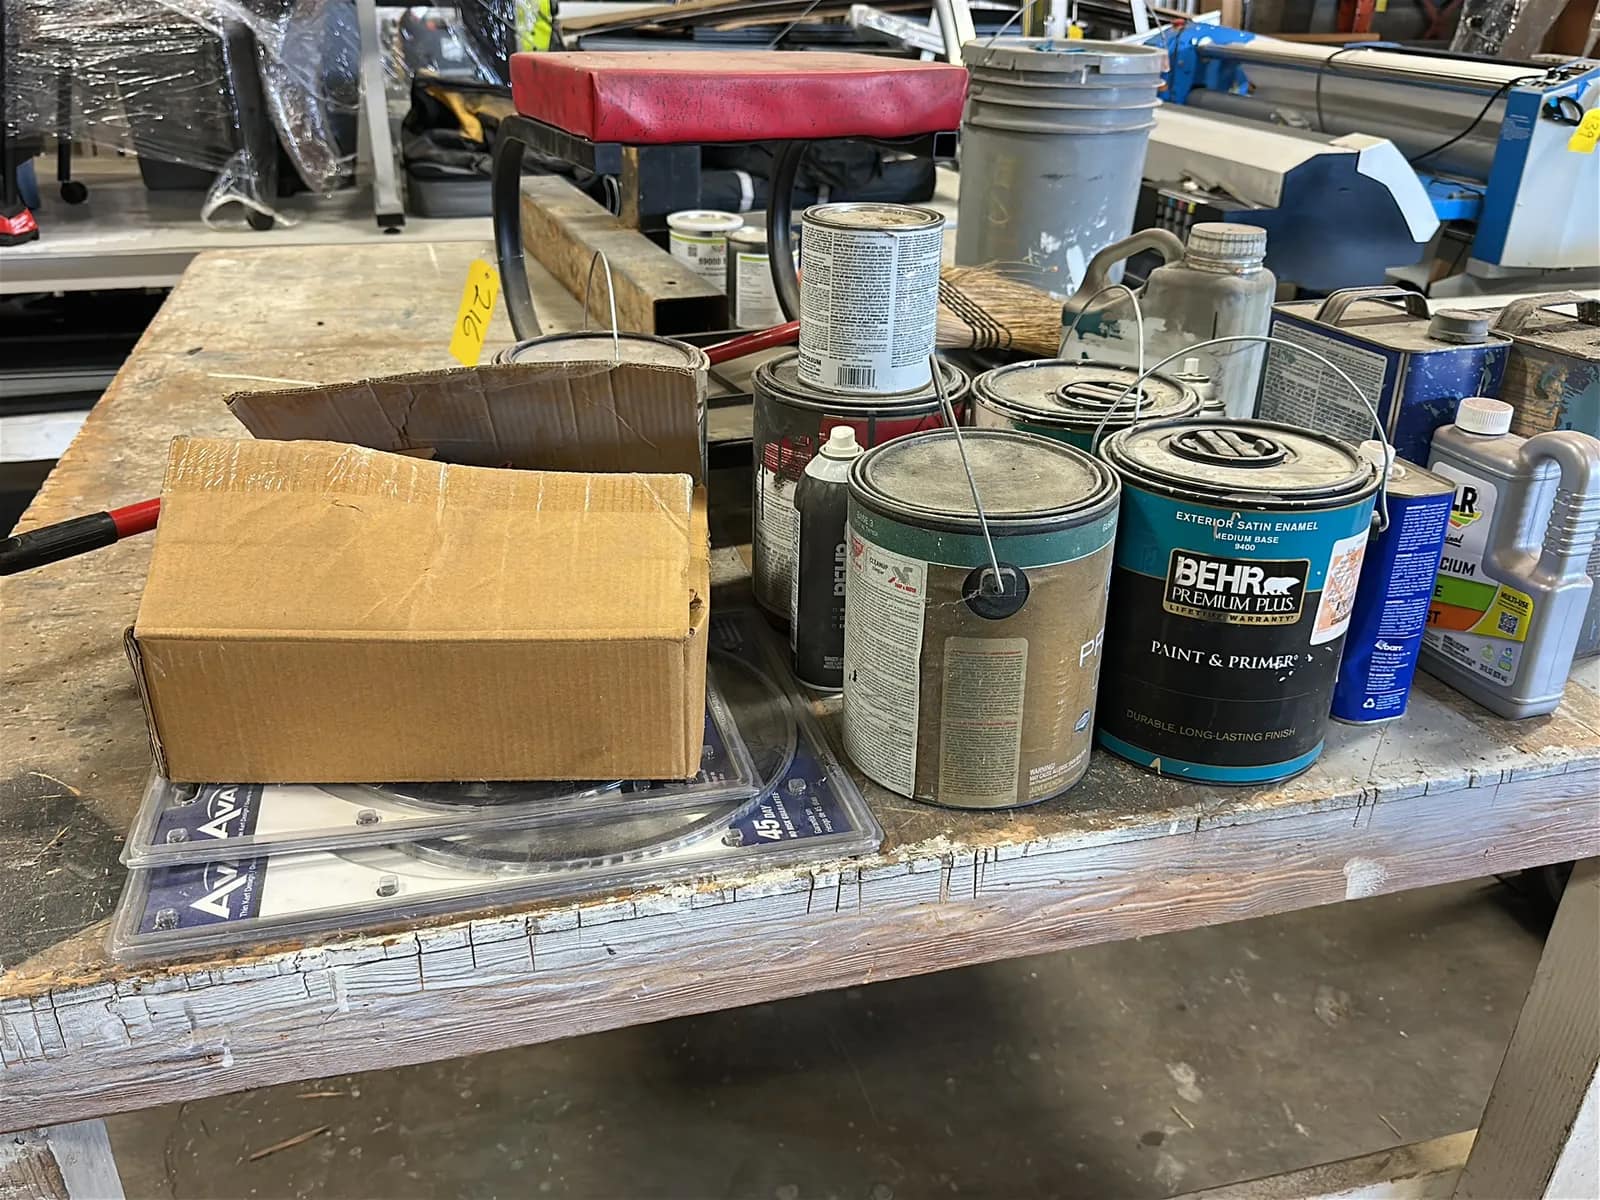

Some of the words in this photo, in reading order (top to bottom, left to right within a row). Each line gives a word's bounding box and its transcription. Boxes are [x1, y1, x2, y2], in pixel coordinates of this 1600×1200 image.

[463, 284, 491, 342] 216
[1452, 486, 1477, 513] LR
[1176, 511, 1233, 529] EXTERIOR
[1236, 520, 1271, 531] SATIN
[1275, 521, 1319, 532] ENAMEL
[1215, 532, 1252, 543] MEDIUM
[1254, 535, 1279, 544] BASE
[1234, 543, 1256, 551] 9400
[1175, 556, 1265, 595] BEHR
[1440, 557, 1475, 577] CIUM
[1172, 585, 1251, 611] PREMIUM
[1151, 640, 1205, 664] PAINT
[1208, 654, 1222, 667] &
[1179, 726, 1263, 742] LONG-LASTING
[1264, 727, 1296, 741] FINISH
[760, 804, 776, 819] DAY
[752, 820, 783, 840] 45
